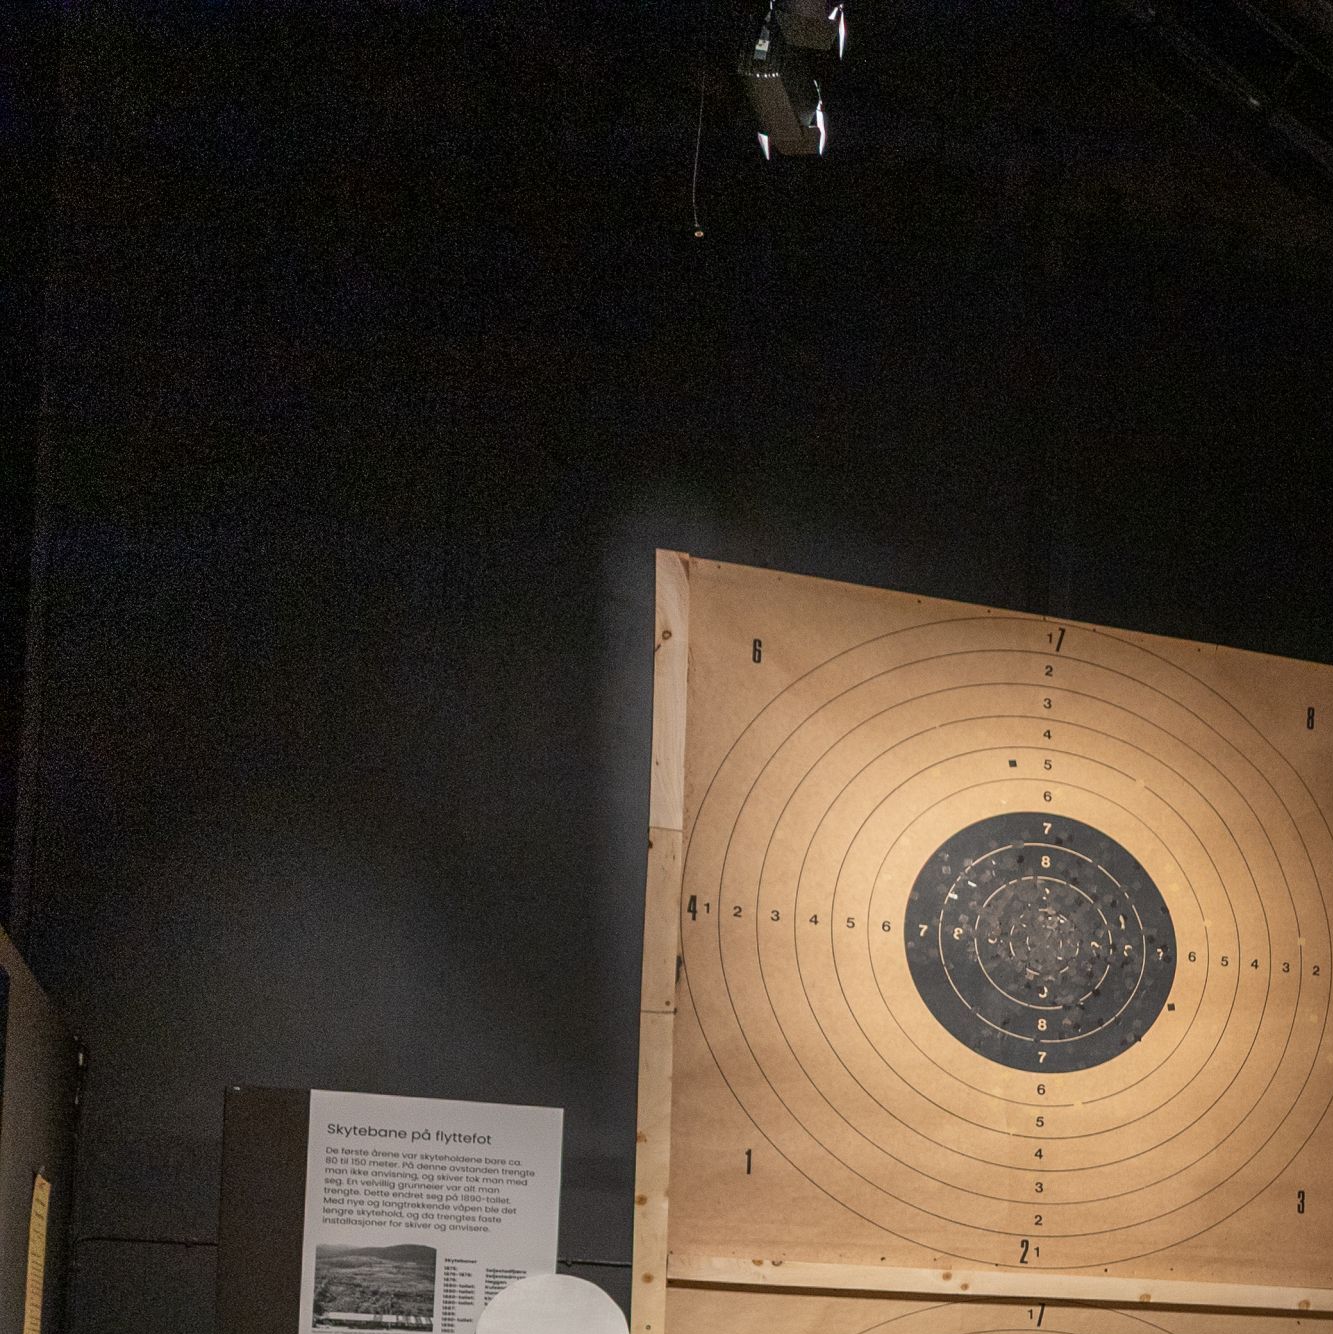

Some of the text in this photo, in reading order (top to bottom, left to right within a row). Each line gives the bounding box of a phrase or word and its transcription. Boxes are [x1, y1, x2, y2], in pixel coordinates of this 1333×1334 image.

[752, 638, 763, 664] 6
[1047, 627, 1067, 653] 1 7
[1044, 664, 1054, 677] 2
[1043, 697, 1053, 710] 3
[1306, 706, 1316, 730] 8
[1043, 729, 1052, 740] 4
[1043, 758, 1053, 771] 5
[1042, 790, 1053, 803] 6
[1042, 822, 1052, 835] 7
[1040, 855, 1051, 869] 8
[686, 894, 928, 937] 4 1 2 3 4 5 6 7
[327, 1123, 491, 1145] Skytebane på flyttefot
[325, 1146, 338, 1154] De
[341, 1148, 369, 1156] første
[371, 1149, 399, 1158] årene
[420, 1153, 482, 1163] skyteholdene
[484, 1157, 506, 1165] bare
[745, 1148, 752, 1175] 1
[325, 1156, 338, 1164] 80
[351, 1158, 366, 1166] 150
[402, 1161, 414, 1169] På
[416, 1162, 447, 1171] denne
[449, 1166, 499, 1174] avstanden
[501, 1168, 535, 1178] trengte
[363, 1189, 390, 1197] Dette
[392, 1191, 423, 1199] endret
[426, 1194, 443, 1202] seg
[445, 1193, 458, 1202] på
[1297, 1190, 1306, 1215] 3
[1019, 1239, 1030, 1264] 2
[1028, 1302, 1046, 1328] 1 7
